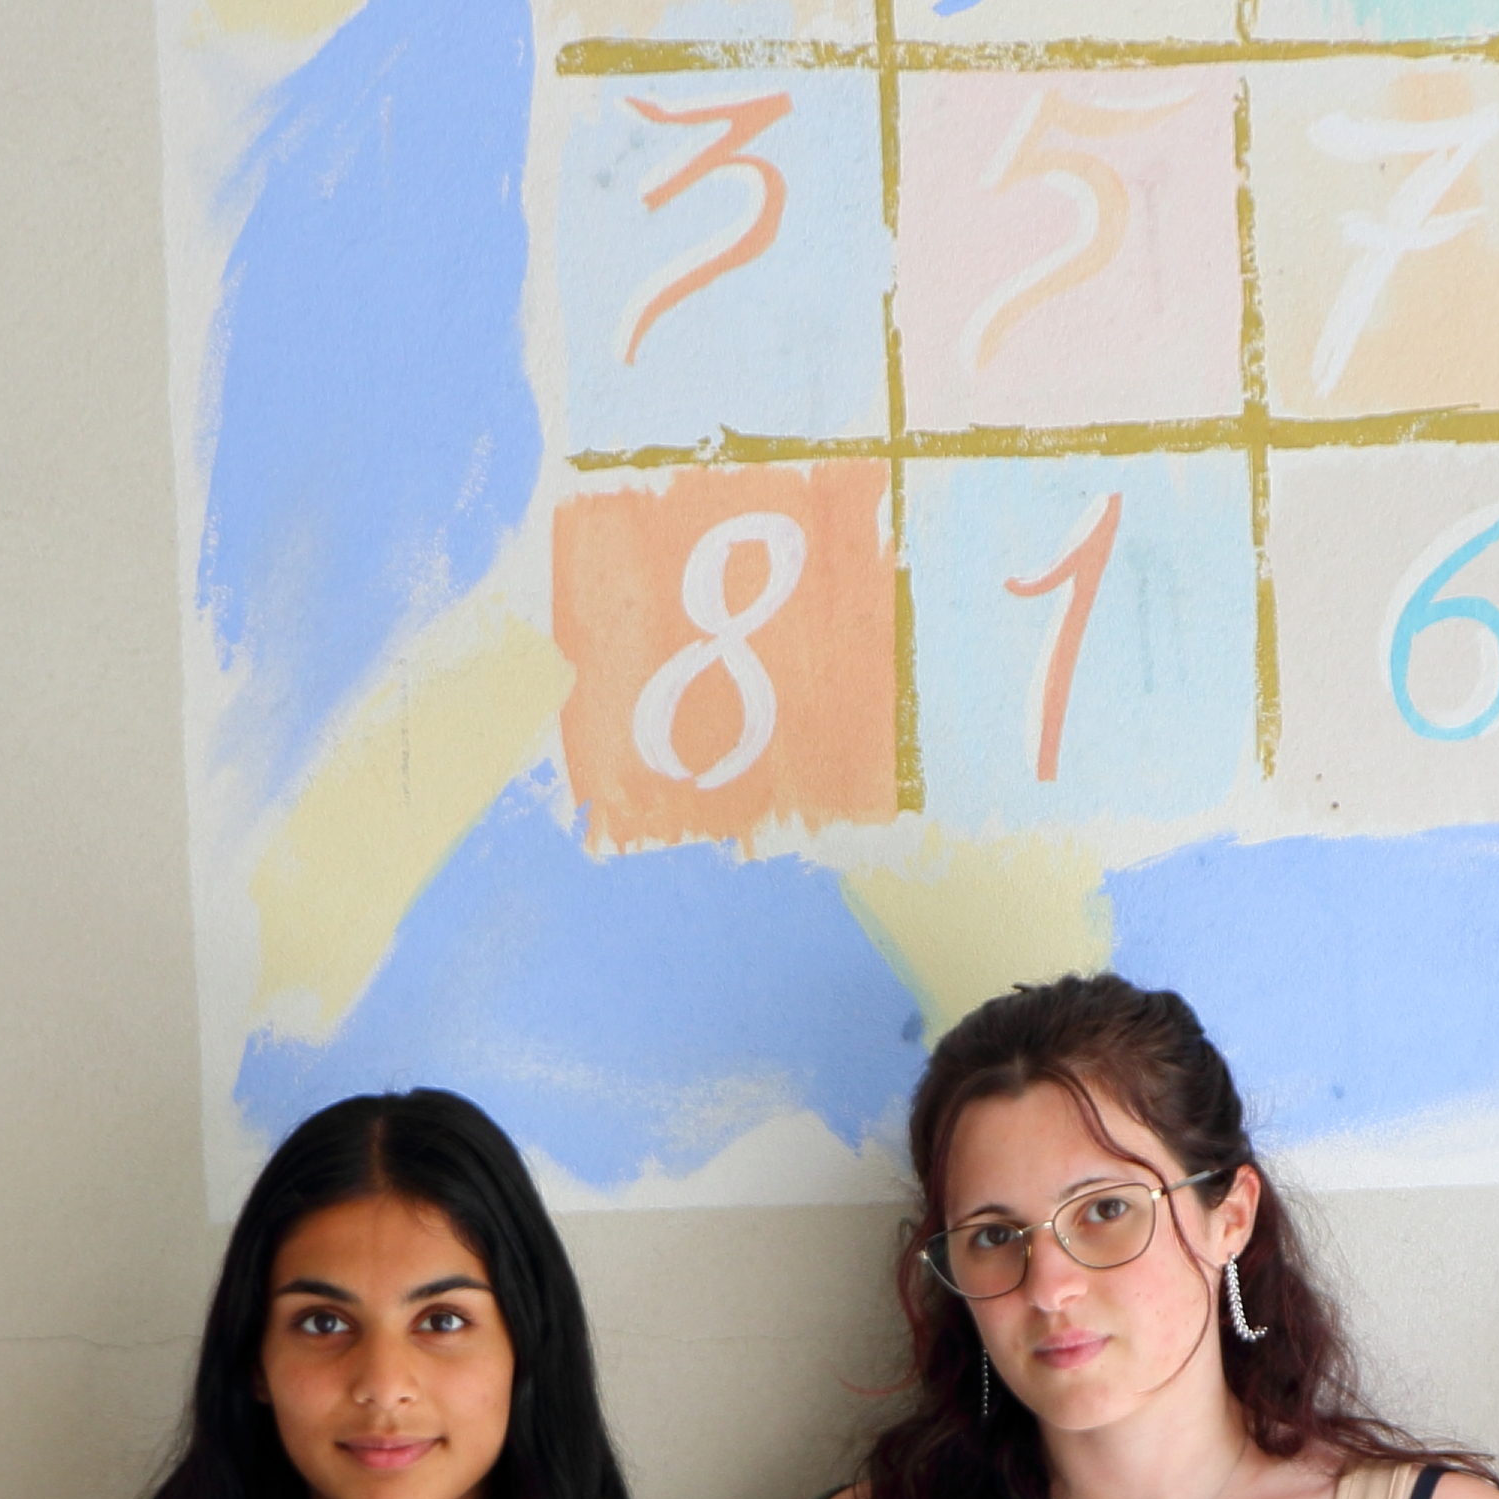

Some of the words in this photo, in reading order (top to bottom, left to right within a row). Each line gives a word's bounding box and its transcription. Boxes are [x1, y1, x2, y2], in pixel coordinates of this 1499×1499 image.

[619, 90, 794, 367] 3
[964, 86, 1199, 372] 5
[632, 510, 808, 789] 8
[1003, 491, 1123, 782] 1
